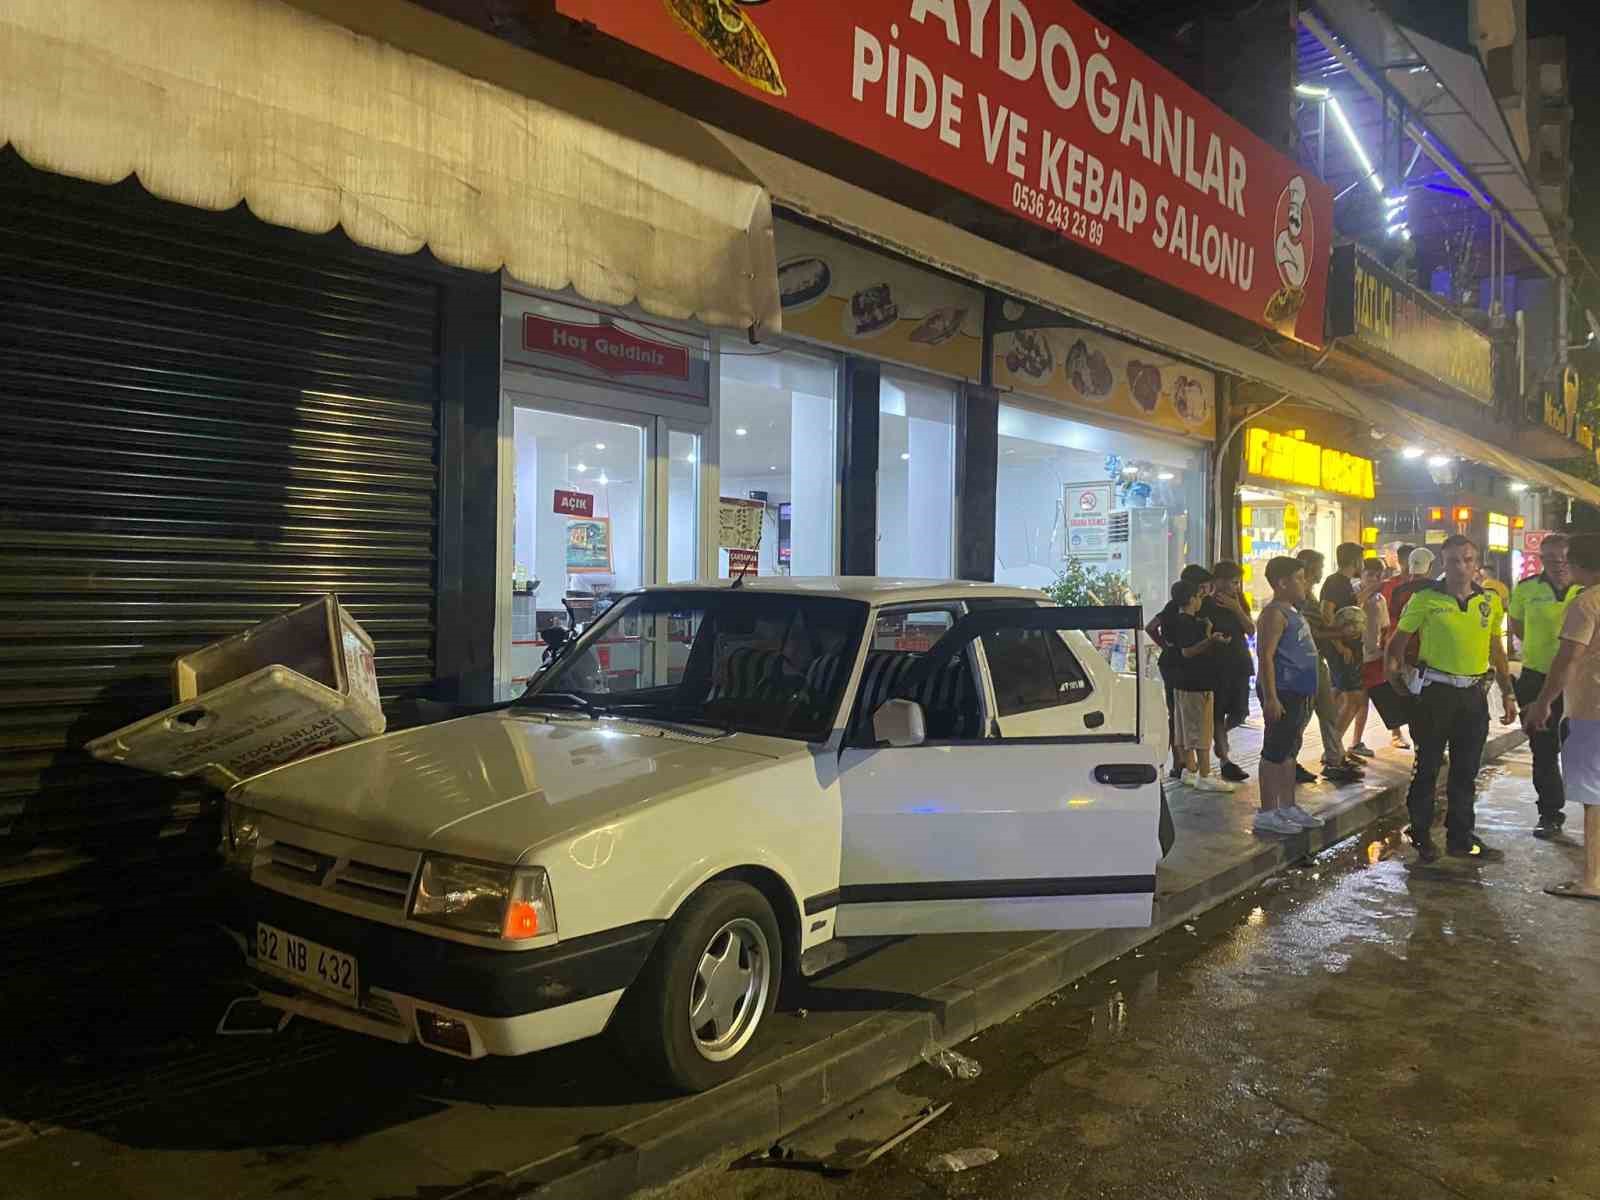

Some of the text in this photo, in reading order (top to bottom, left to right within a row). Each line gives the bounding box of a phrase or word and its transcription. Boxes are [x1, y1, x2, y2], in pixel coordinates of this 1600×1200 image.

[852, 24, 1255, 291] PİDE VE KEBAP SALONU
[1012, 182, 1104, 246] 0536 243 23 89
[552, 327, 665, 366] Hoş Geldiniz
[561, 496, 588, 511] AÇIK
[259, 928, 352, 989] 32 NB 432
